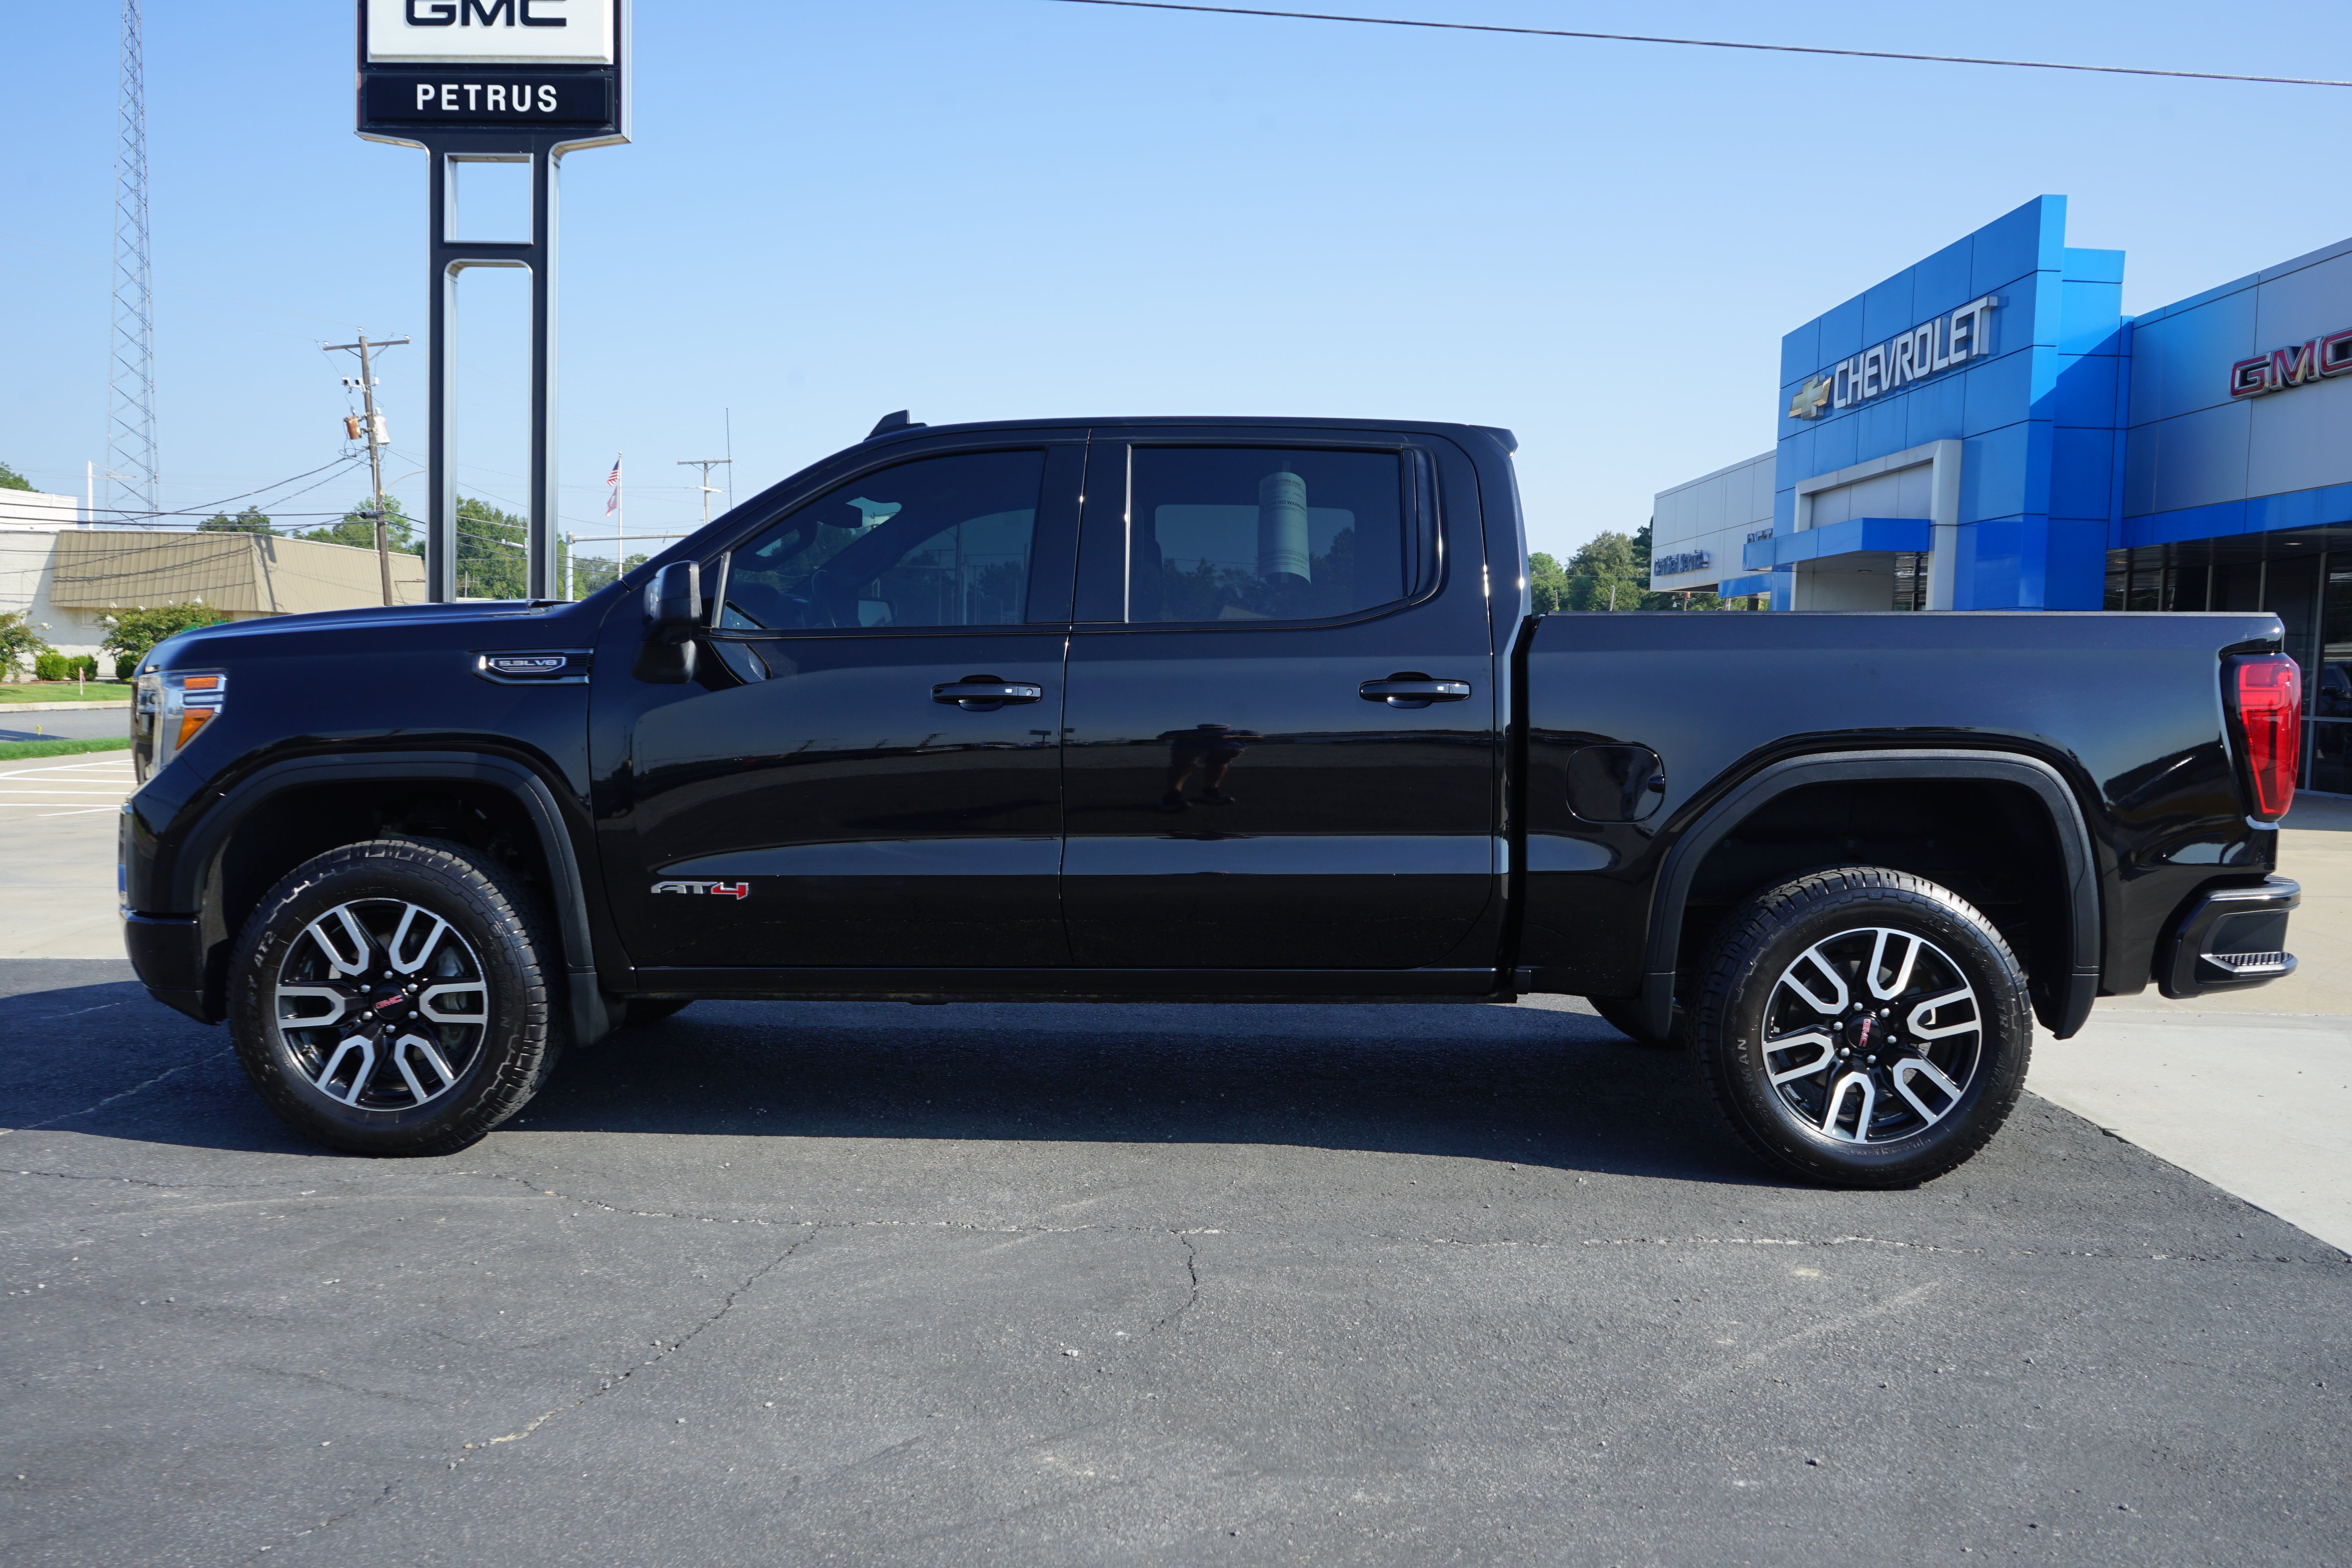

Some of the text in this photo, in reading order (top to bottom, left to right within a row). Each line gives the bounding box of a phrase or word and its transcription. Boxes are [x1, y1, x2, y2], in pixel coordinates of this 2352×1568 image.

[406, 0, 567, 27] GMC
[416, 84, 557, 113] PETRUS
[1833, 296, 1998, 409] CHEVROLET
[2229, 326, 2352, 399] GMC
[651, 881, 749, 900] AT4
[253, 930, 278, 969] AT2
[374, 995, 404, 1009] GMC
[1968, 946, 2009, 1043] COUNTRY
[1858, 1018, 1871, 1047] GMC
